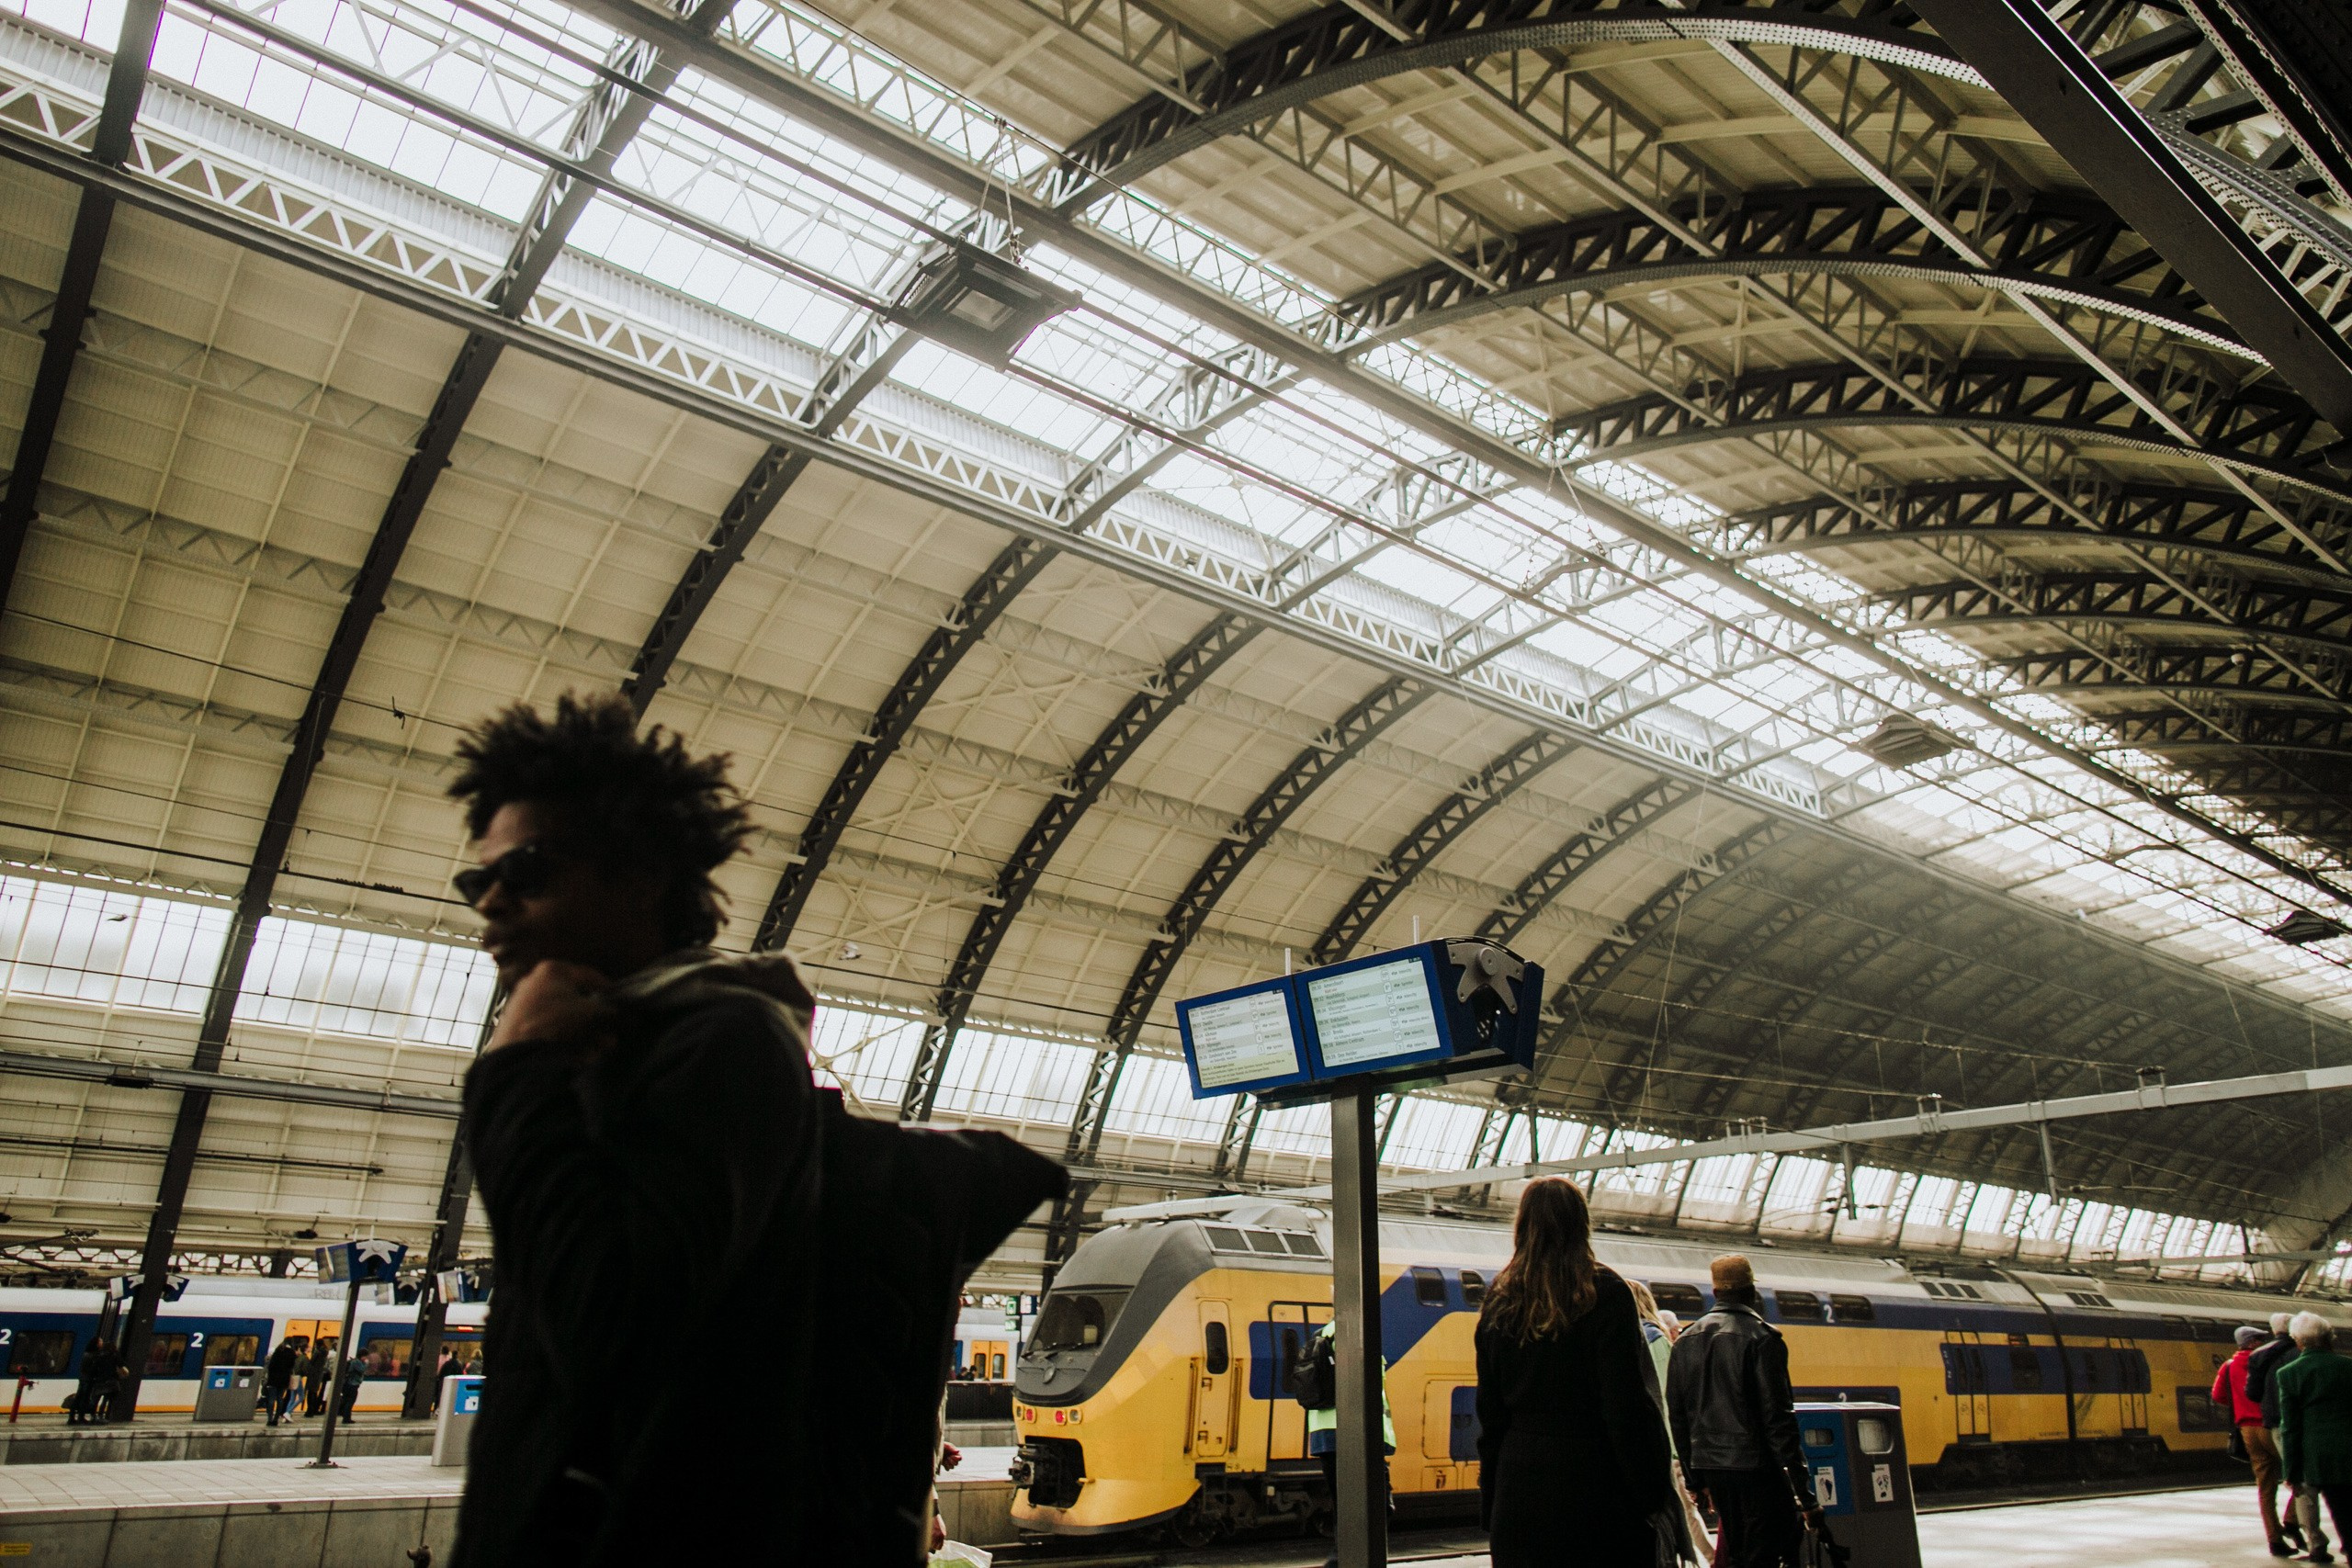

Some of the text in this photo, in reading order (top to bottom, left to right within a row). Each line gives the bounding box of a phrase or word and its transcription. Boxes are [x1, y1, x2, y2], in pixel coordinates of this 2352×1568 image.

[1824, 1304, 1835, 1323] 2
[0, 1328, 12, 1345] 2
[191, 1333, 204, 1348] 2
